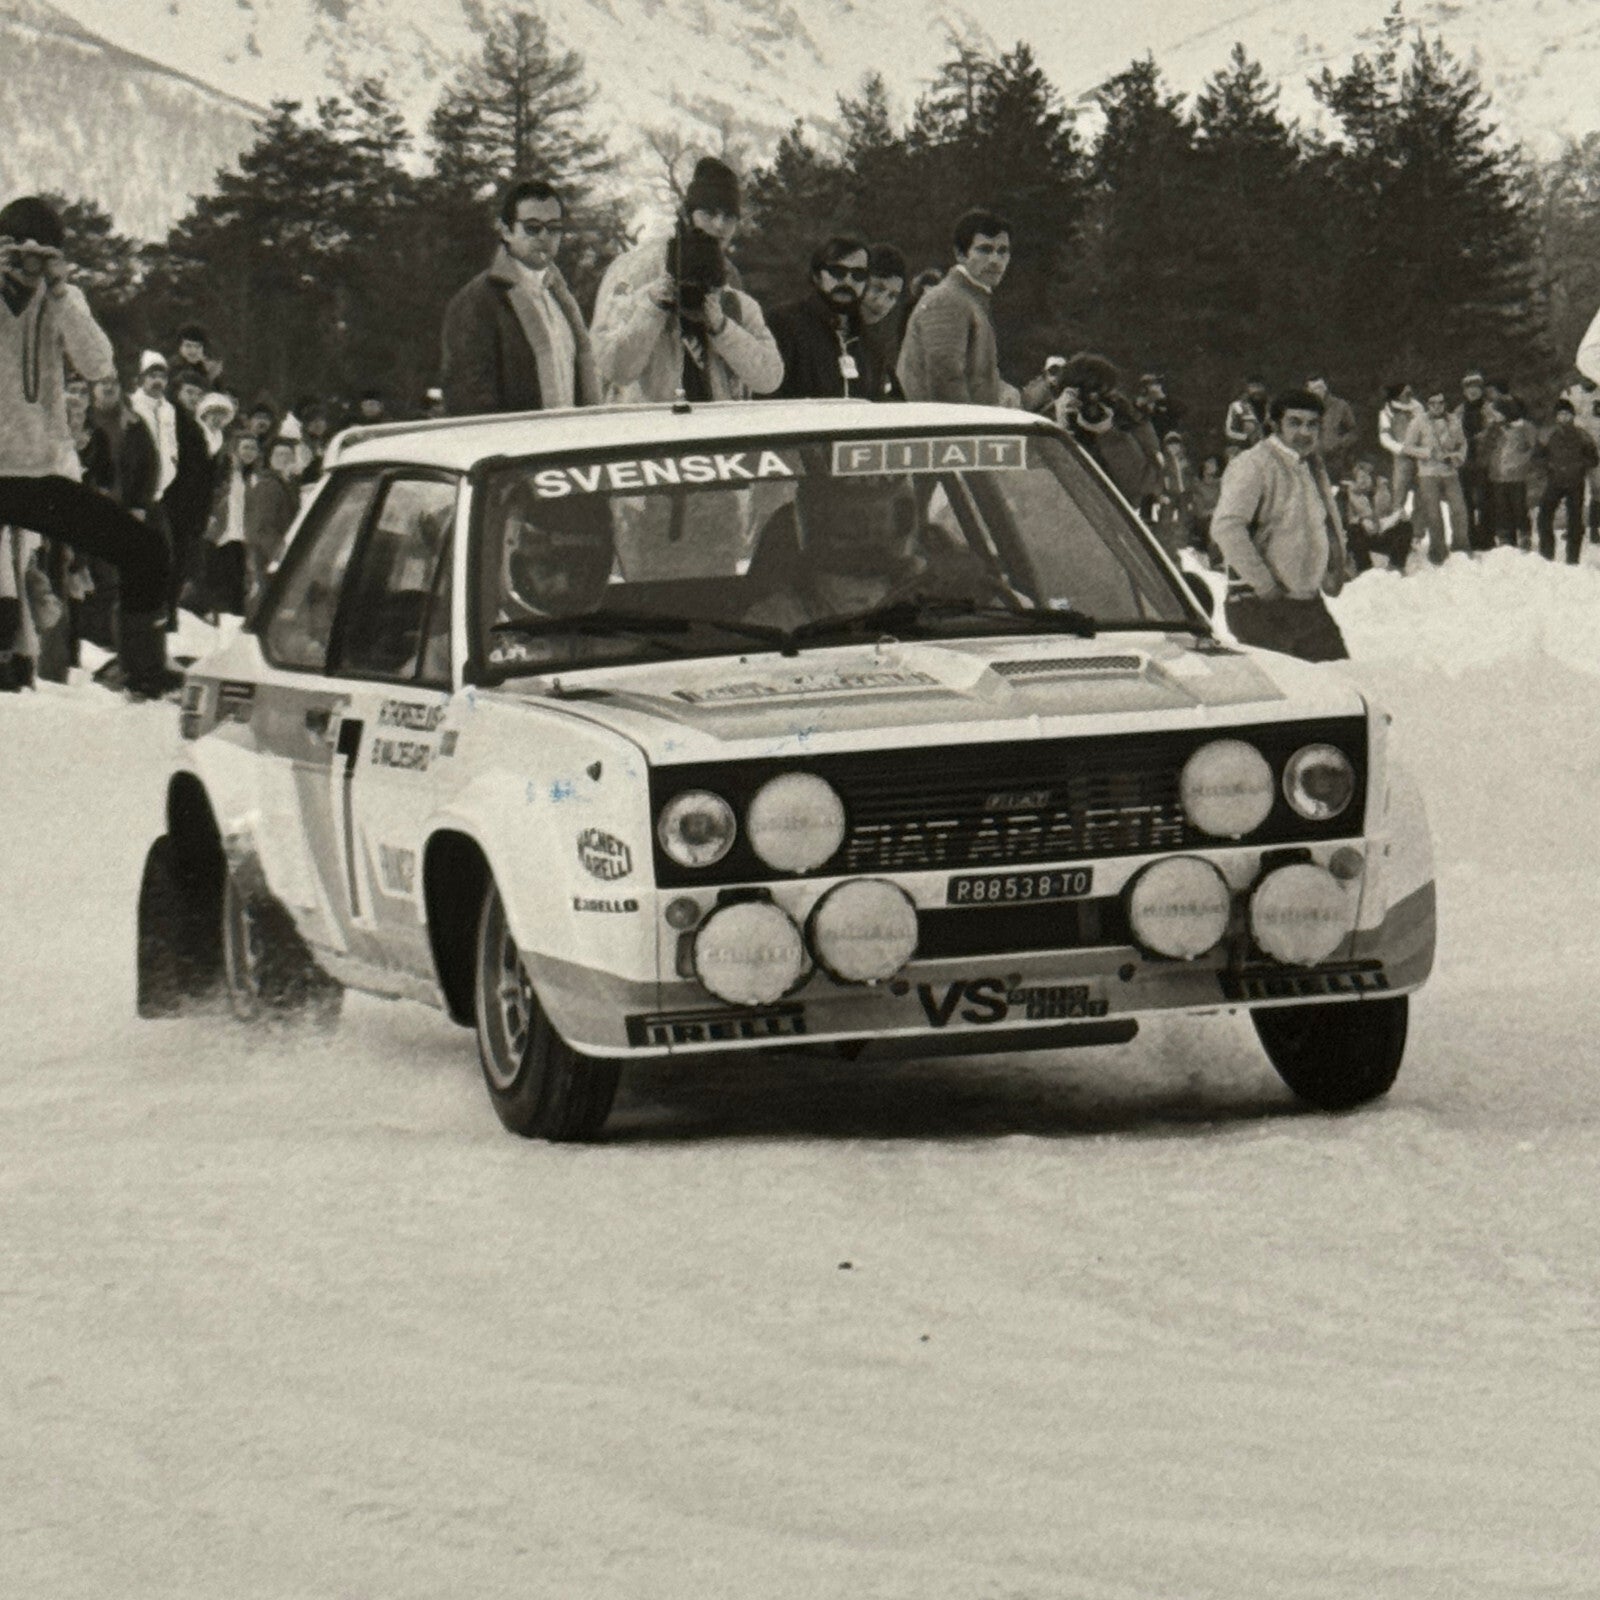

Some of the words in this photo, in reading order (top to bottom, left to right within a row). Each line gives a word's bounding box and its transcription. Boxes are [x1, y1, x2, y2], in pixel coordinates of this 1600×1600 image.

[533, 450, 794, 499] SVENSKA
[848, 441, 1014, 471] FIAT
[847, 820, 959, 867] FIAT
[957, 875, 1051, 899] R88538
[917, 977, 1009, 1028] VS
